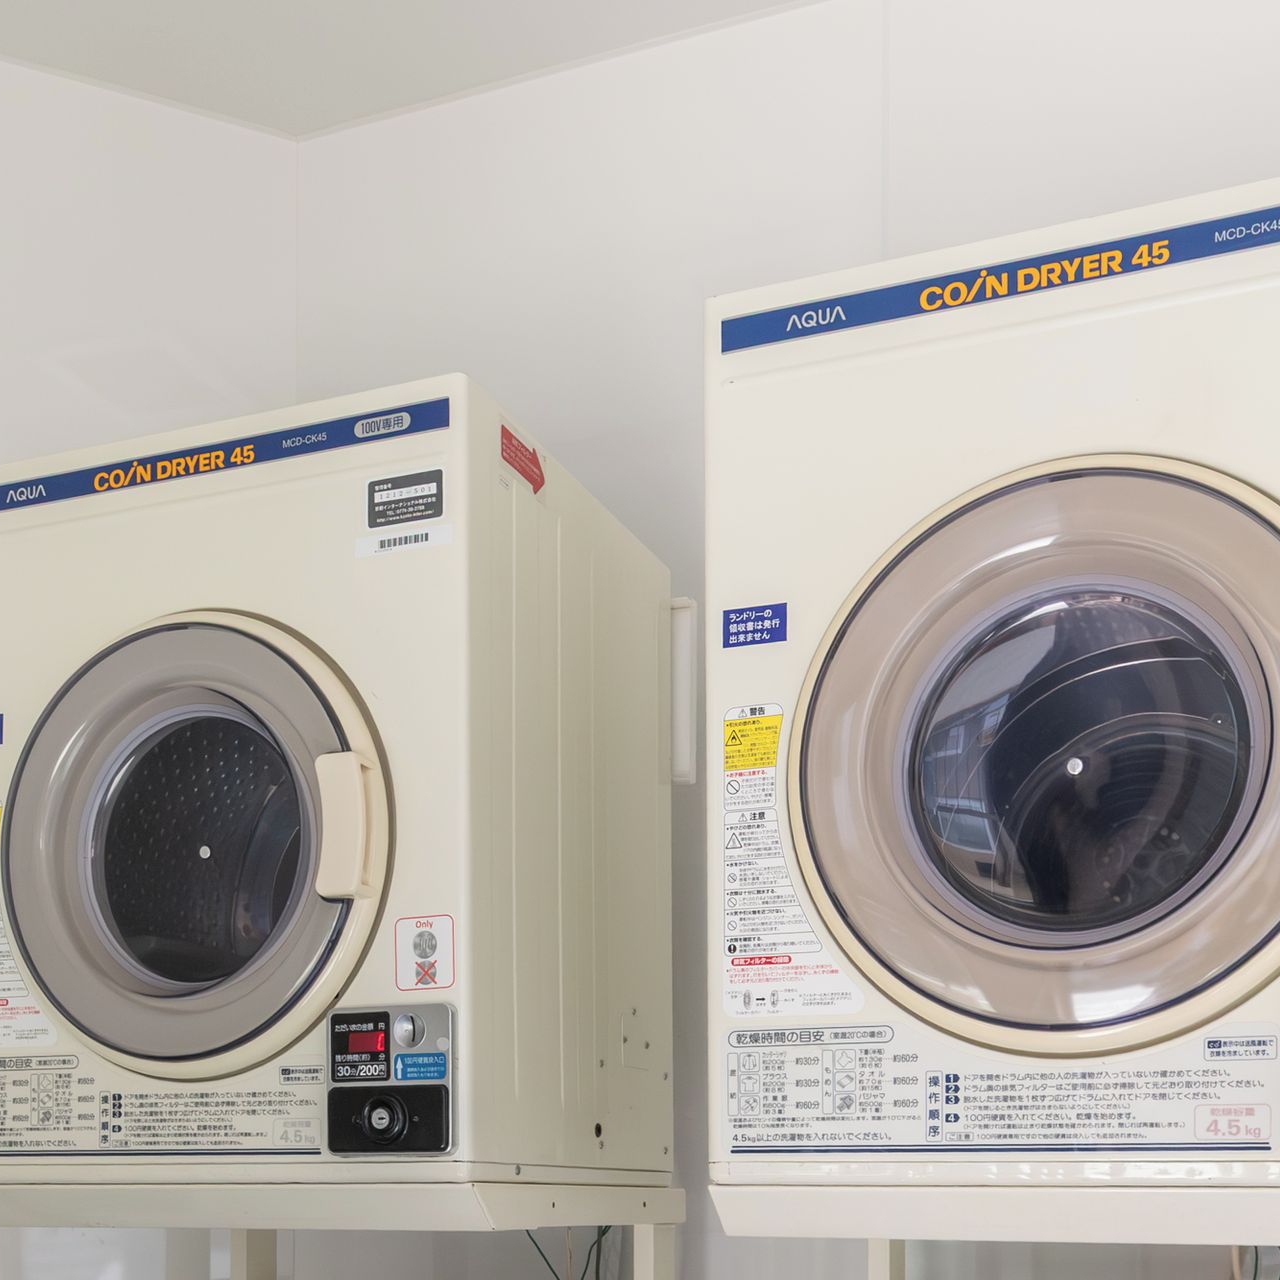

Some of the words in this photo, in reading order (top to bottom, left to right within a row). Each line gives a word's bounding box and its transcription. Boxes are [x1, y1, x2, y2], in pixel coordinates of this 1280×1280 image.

[1017, 249, 1123, 293] DRYER
[1131, 239, 1170, 267] 45
[786, 305, 846, 332] AQUA
[361, 416, 404, 435] 100V専用
[282, 432, 327, 449] MCD-CK45
[157, 450, 225, 479] DRYER
[230, 444, 255, 465] 45
[7, 484, 46, 503] AQUA
[729, 608, 773, 623] ランドリーの
[729, 618, 780, 633] 領収書は発行
[729, 630, 771, 644] 出来ません
[750, 707, 765, 716] 警告
[750, 812, 766, 821] 注意
[416, 920, 434, 929] Only
[736, 1030, 825, 1044] 乾燥時間の目安
[795, 1057, 820, 1066] 約30分
[893, 1054, 919, 1063] 約60分
[893, 1076, 919, 1085] 約60分
[964, 1070, 1231, 1082] ドアを開きドラム内に他の人の洗濯物が入っていないか確かめてください。
[795, 1079, 820, 1087] 約30分
[964, 1080, 1265, 1093] ドラム奥の排気フィルターはご使用前に必ず掃除して元どおり取り付けてください。
[859, 1092, 885, 1100] パジャマ
[795, 1101, 820, 1109] 約60分
[893, 1099, 919, 1107] 約60分
[928, 1076, 940, 1137] 操作順序
[965, 1112, 1136, 1121] 100円硬貨を入れてください。乾燥を始めます。
[1206, 1119, 1240, 1136] 4.5
[1245, 1126, 1261, 1138] kg
[280, 1130, 302, 1144] 4.5
[304, 1134, 316, 1145] kg
[733, 1132, 892, 1143] 4.5kg以上の洗濯物を入れないでください。
